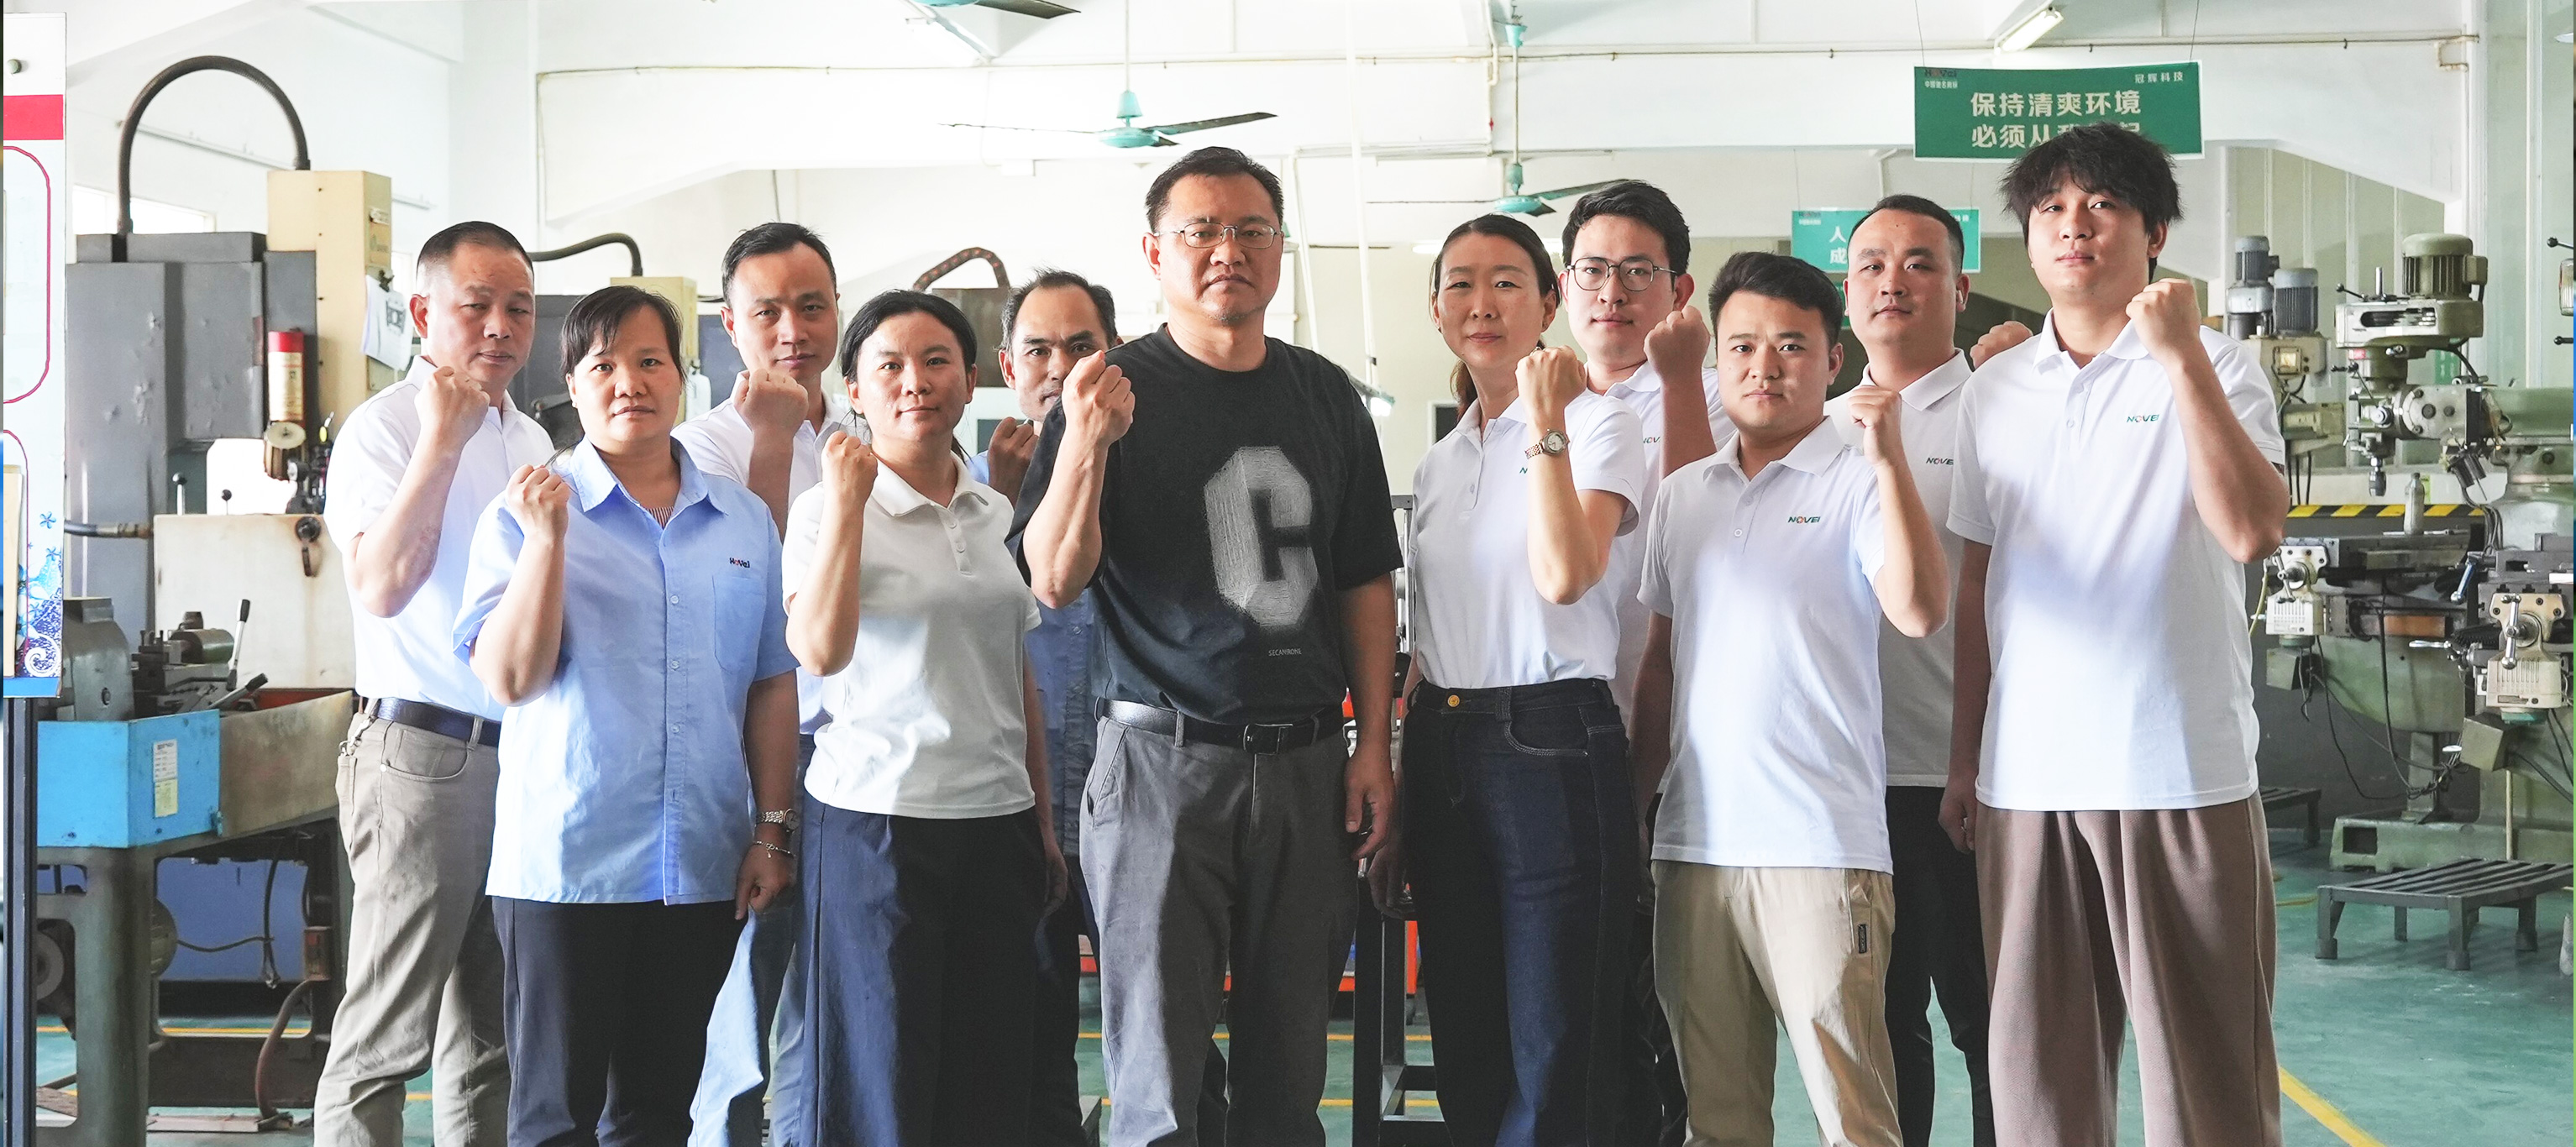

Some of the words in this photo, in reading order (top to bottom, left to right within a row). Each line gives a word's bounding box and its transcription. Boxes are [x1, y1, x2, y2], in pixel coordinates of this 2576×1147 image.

[1970, 90, 2141, 117] 保持清爽环境
[1971, 122, 2140, 149] 必须从
[1204, 446, 1319, 626] C
